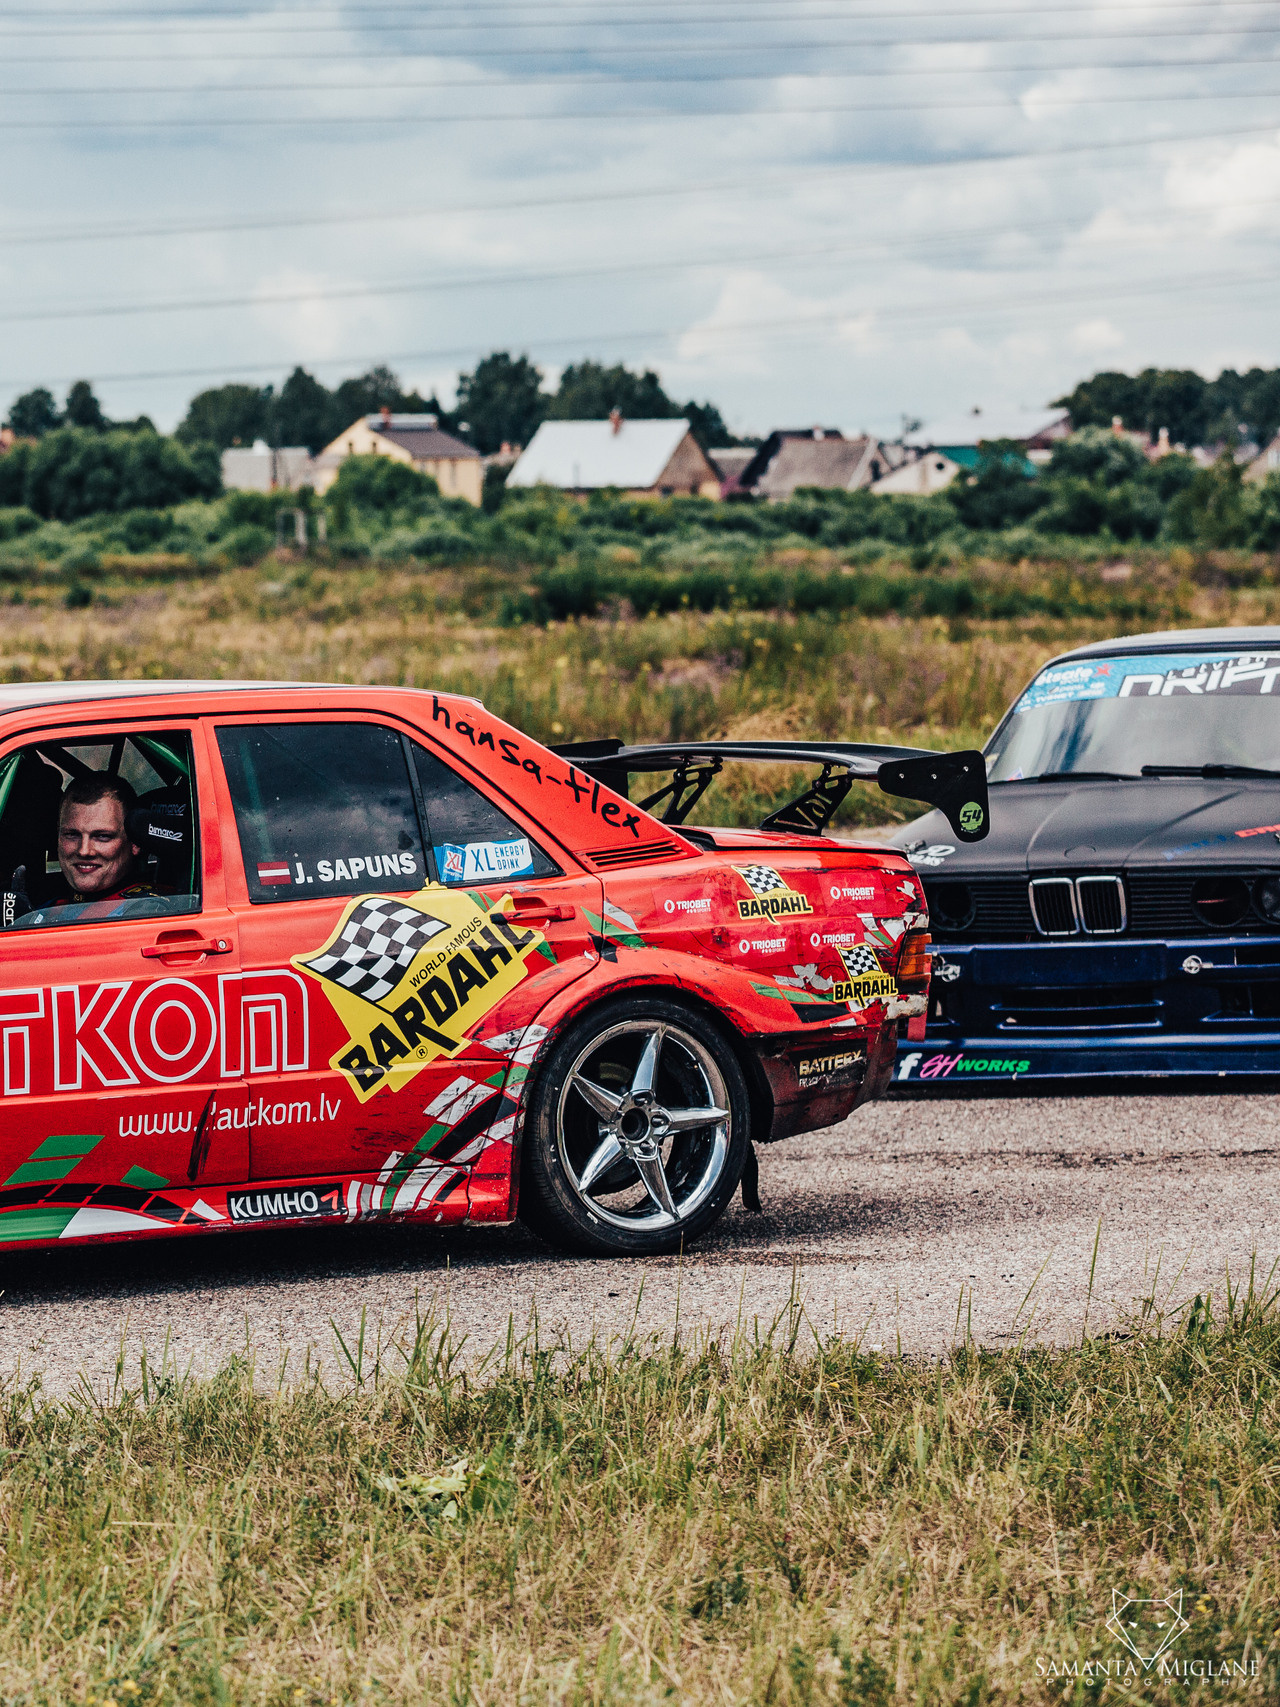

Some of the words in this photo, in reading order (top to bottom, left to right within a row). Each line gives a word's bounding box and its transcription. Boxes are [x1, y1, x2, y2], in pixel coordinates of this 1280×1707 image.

[432, 695, 641, 838] hansa-flex
[960, 809, 982, 824] 54
[295, 862, 313, 885] J.
[317, 852, 417, 881] SAPUNS
[470, 848, 496, 872] XL
[494, 845, 526, 858] ENERGY
[497, 859, 520, 870] DRINK
[676, 899, 711, 910] TRIOBET
[842, 886, 875, 897] TRIOBET
[739, 896, 811, 924] BARDAHL
[751, 938, 786, 950] TRIOBET
[822, 932, 855, 944] TRIOBET
[409, 952, 447, 988] WORLD
[445, 916, 482, 955] FAMOUS
[834, 979, 897, 1007] BARDAHL
[338, 922, 536, 1093] BARDAHL
[231, 1191, 318, 1218] KUMHO
